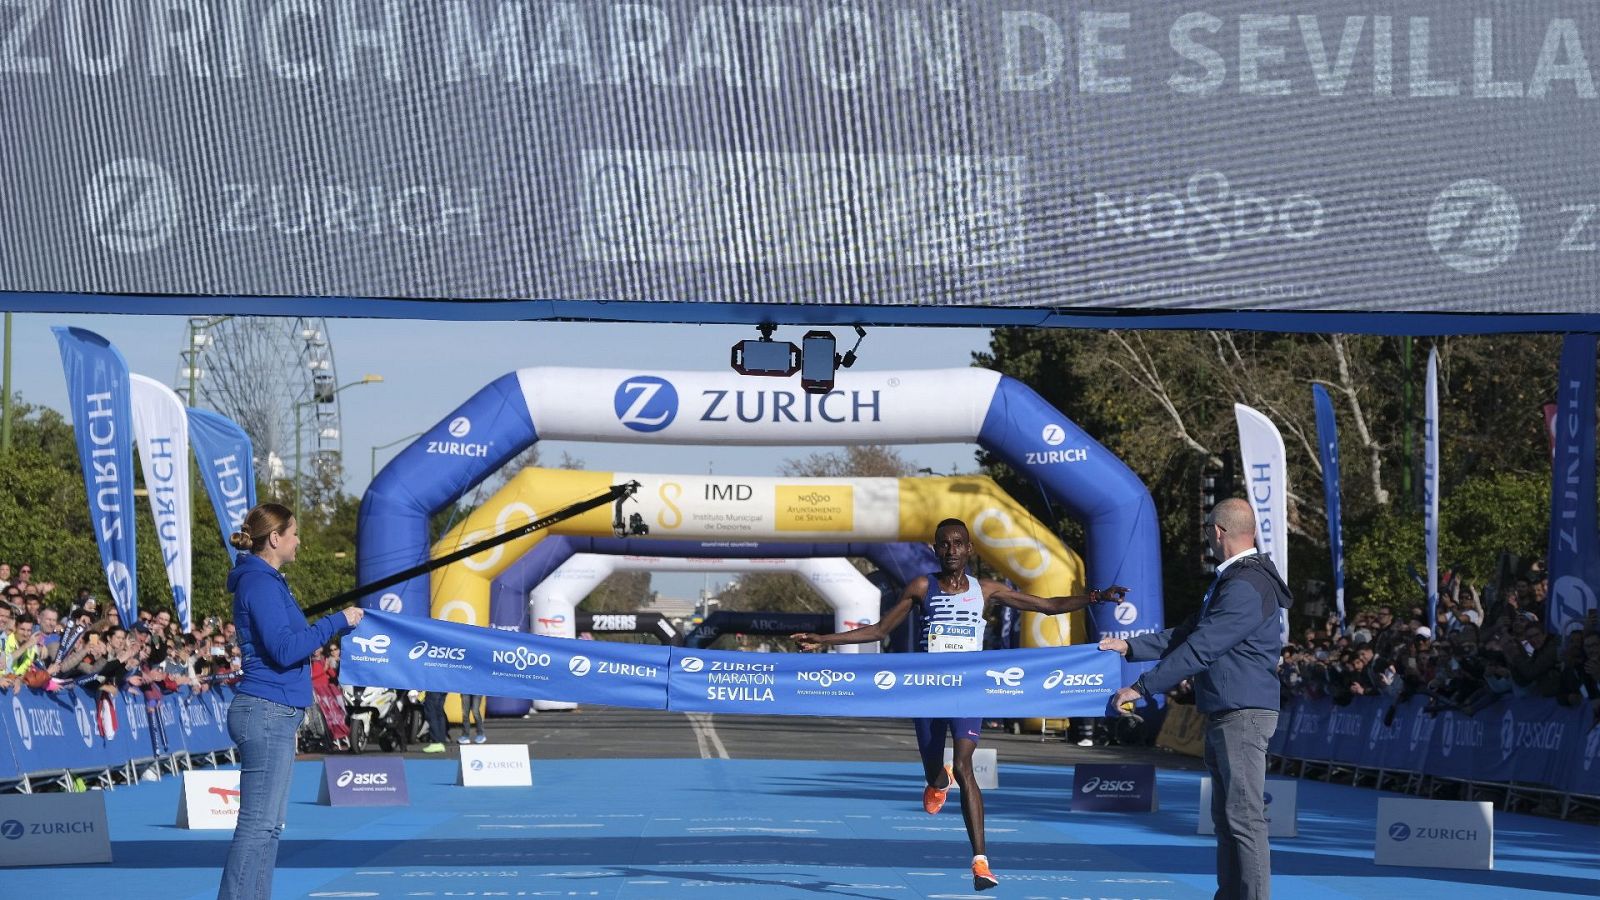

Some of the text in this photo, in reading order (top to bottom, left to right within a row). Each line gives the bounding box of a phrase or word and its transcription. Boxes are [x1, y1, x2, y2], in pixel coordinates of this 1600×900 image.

[1, 0, 400, 82] ZURICH
[1001, 10, 1131, 94] DE
[1168, 13, 1598, 99] SEVILLA
[220, 183, 483, 238] ZURICH
[700, 390, 881, 423] ZURICH
[427, 441, 488, 458] ZURICH
[1026, 449, 1087, 465] ZURICH
[705, 484, 753, 501] IMD
[592, 615, 637, 630] 226ERS
[428, 645, 466, 661] asics
[599, 661, 657, 678] ZURICH
[711, 661, 774, 672] ZURICH
[708, 672, 774, 685] MARATÓN
[903, 674, 963, 687] ZURICH
[1063, 674, 1104, 686] asics
[707, 686, 775, 701] SEVILLA
[985, 688, 1024, 696] TotalEnergies
[29, 708, 64, 737] ZURICH
[487, 761, 523, 769] ZURICH
[353, 773, 388, 785] asics
[1099, 780, 1135, 791] asics
[30, 821, 94, 835] ZURICH
[1416, 828, 1477, 841] ZURICH
